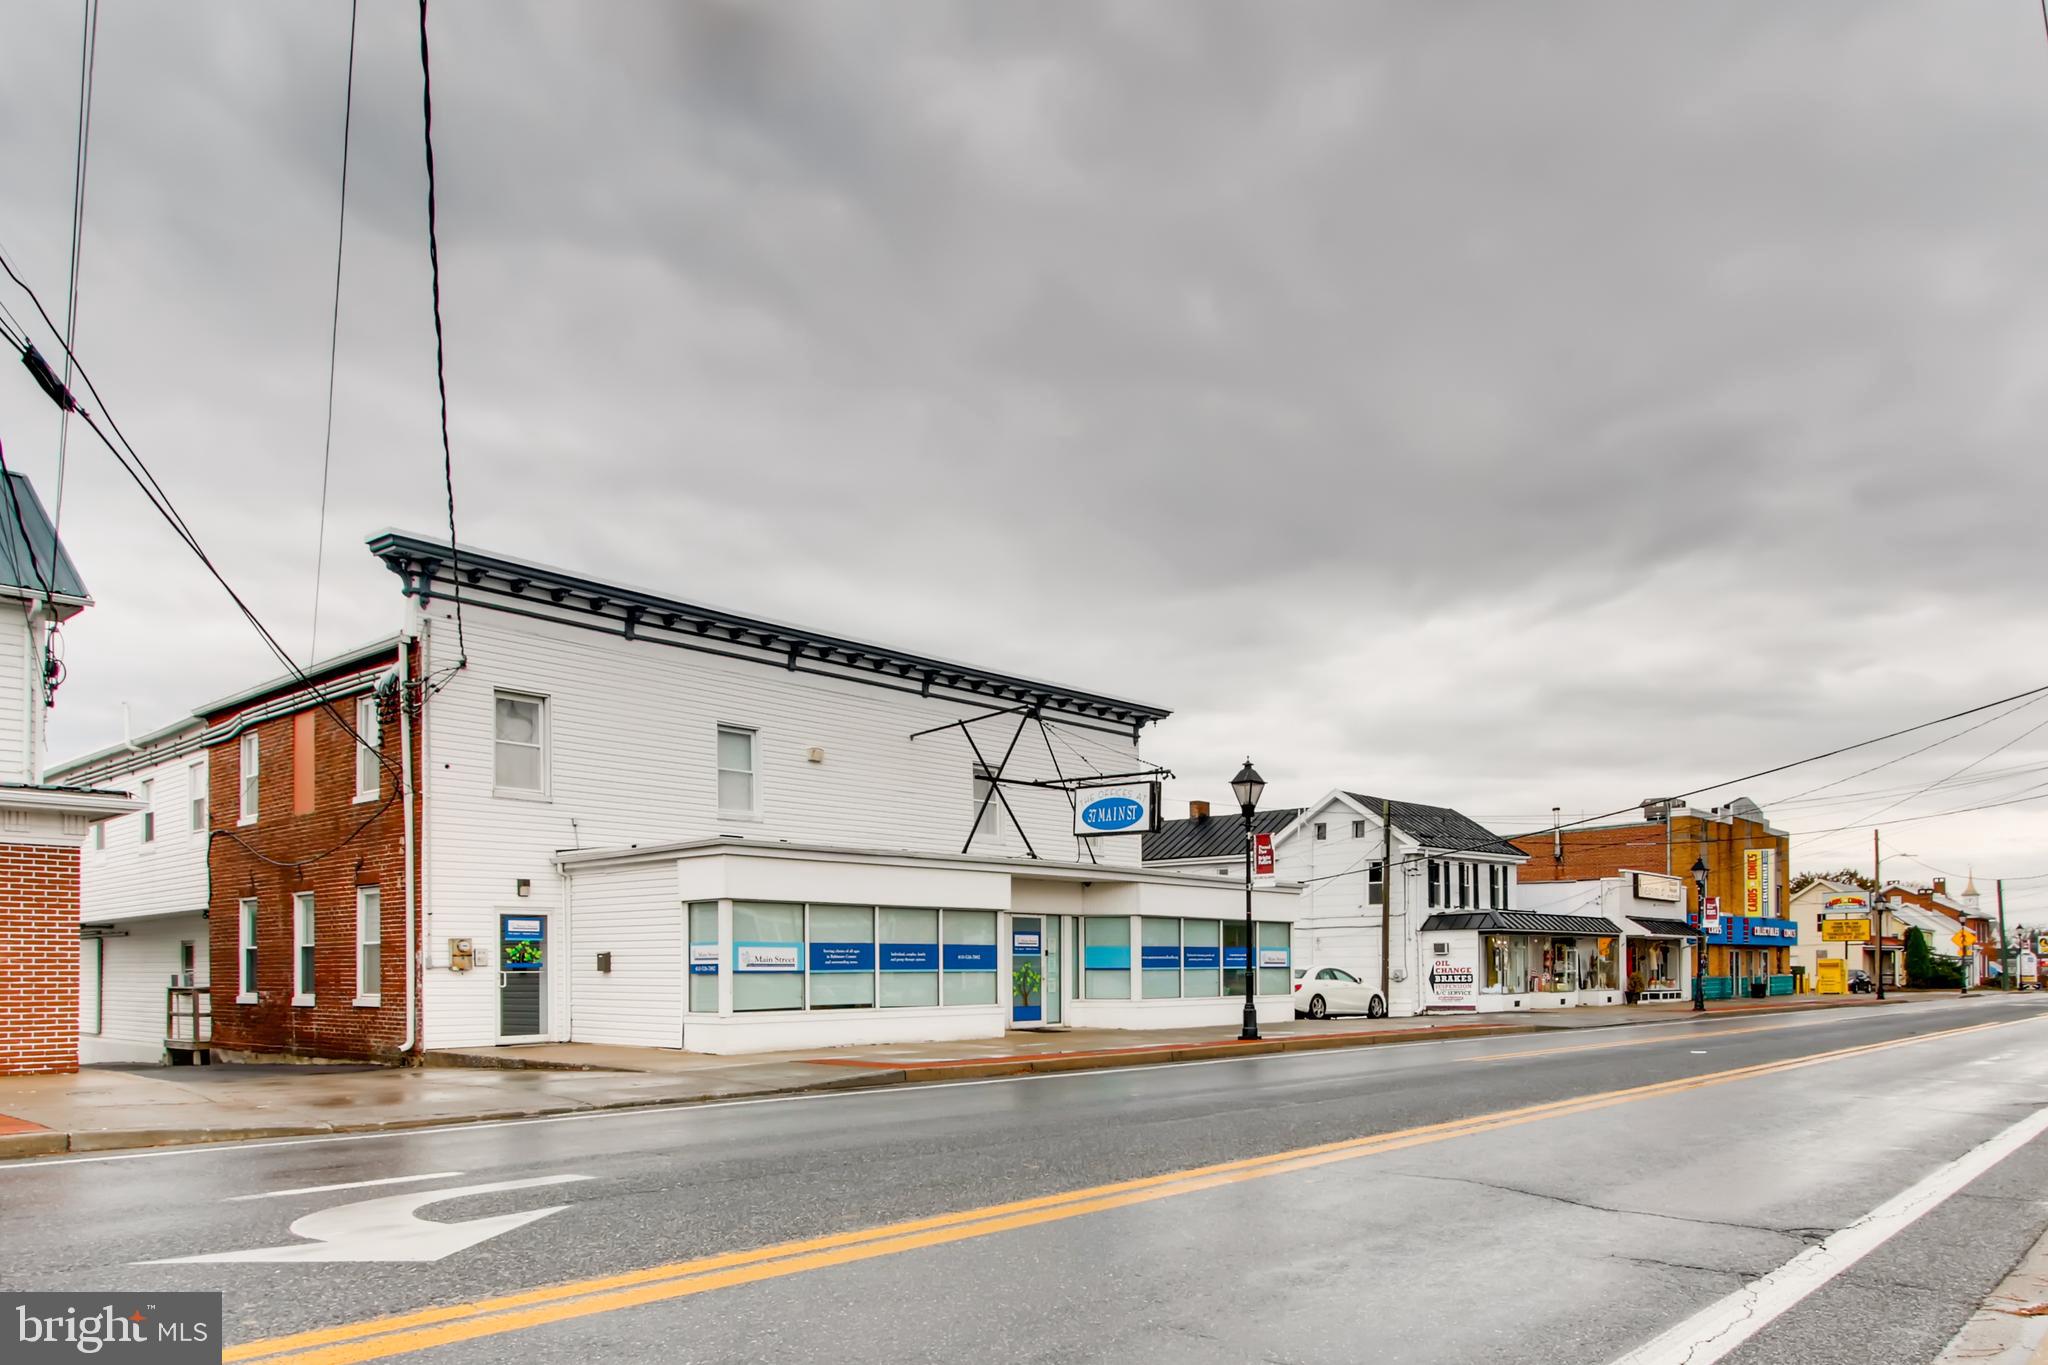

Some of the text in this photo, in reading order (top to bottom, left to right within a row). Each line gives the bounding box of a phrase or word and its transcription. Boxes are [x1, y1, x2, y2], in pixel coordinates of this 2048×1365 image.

[1087, 805, 1138, 823] 37 MAIN ST
[1747, 854, 1758, 912] CARDS COMICS
[754, 955, 796, 963] Main Street
[1434, 975, 1473, 983] BRAKES
